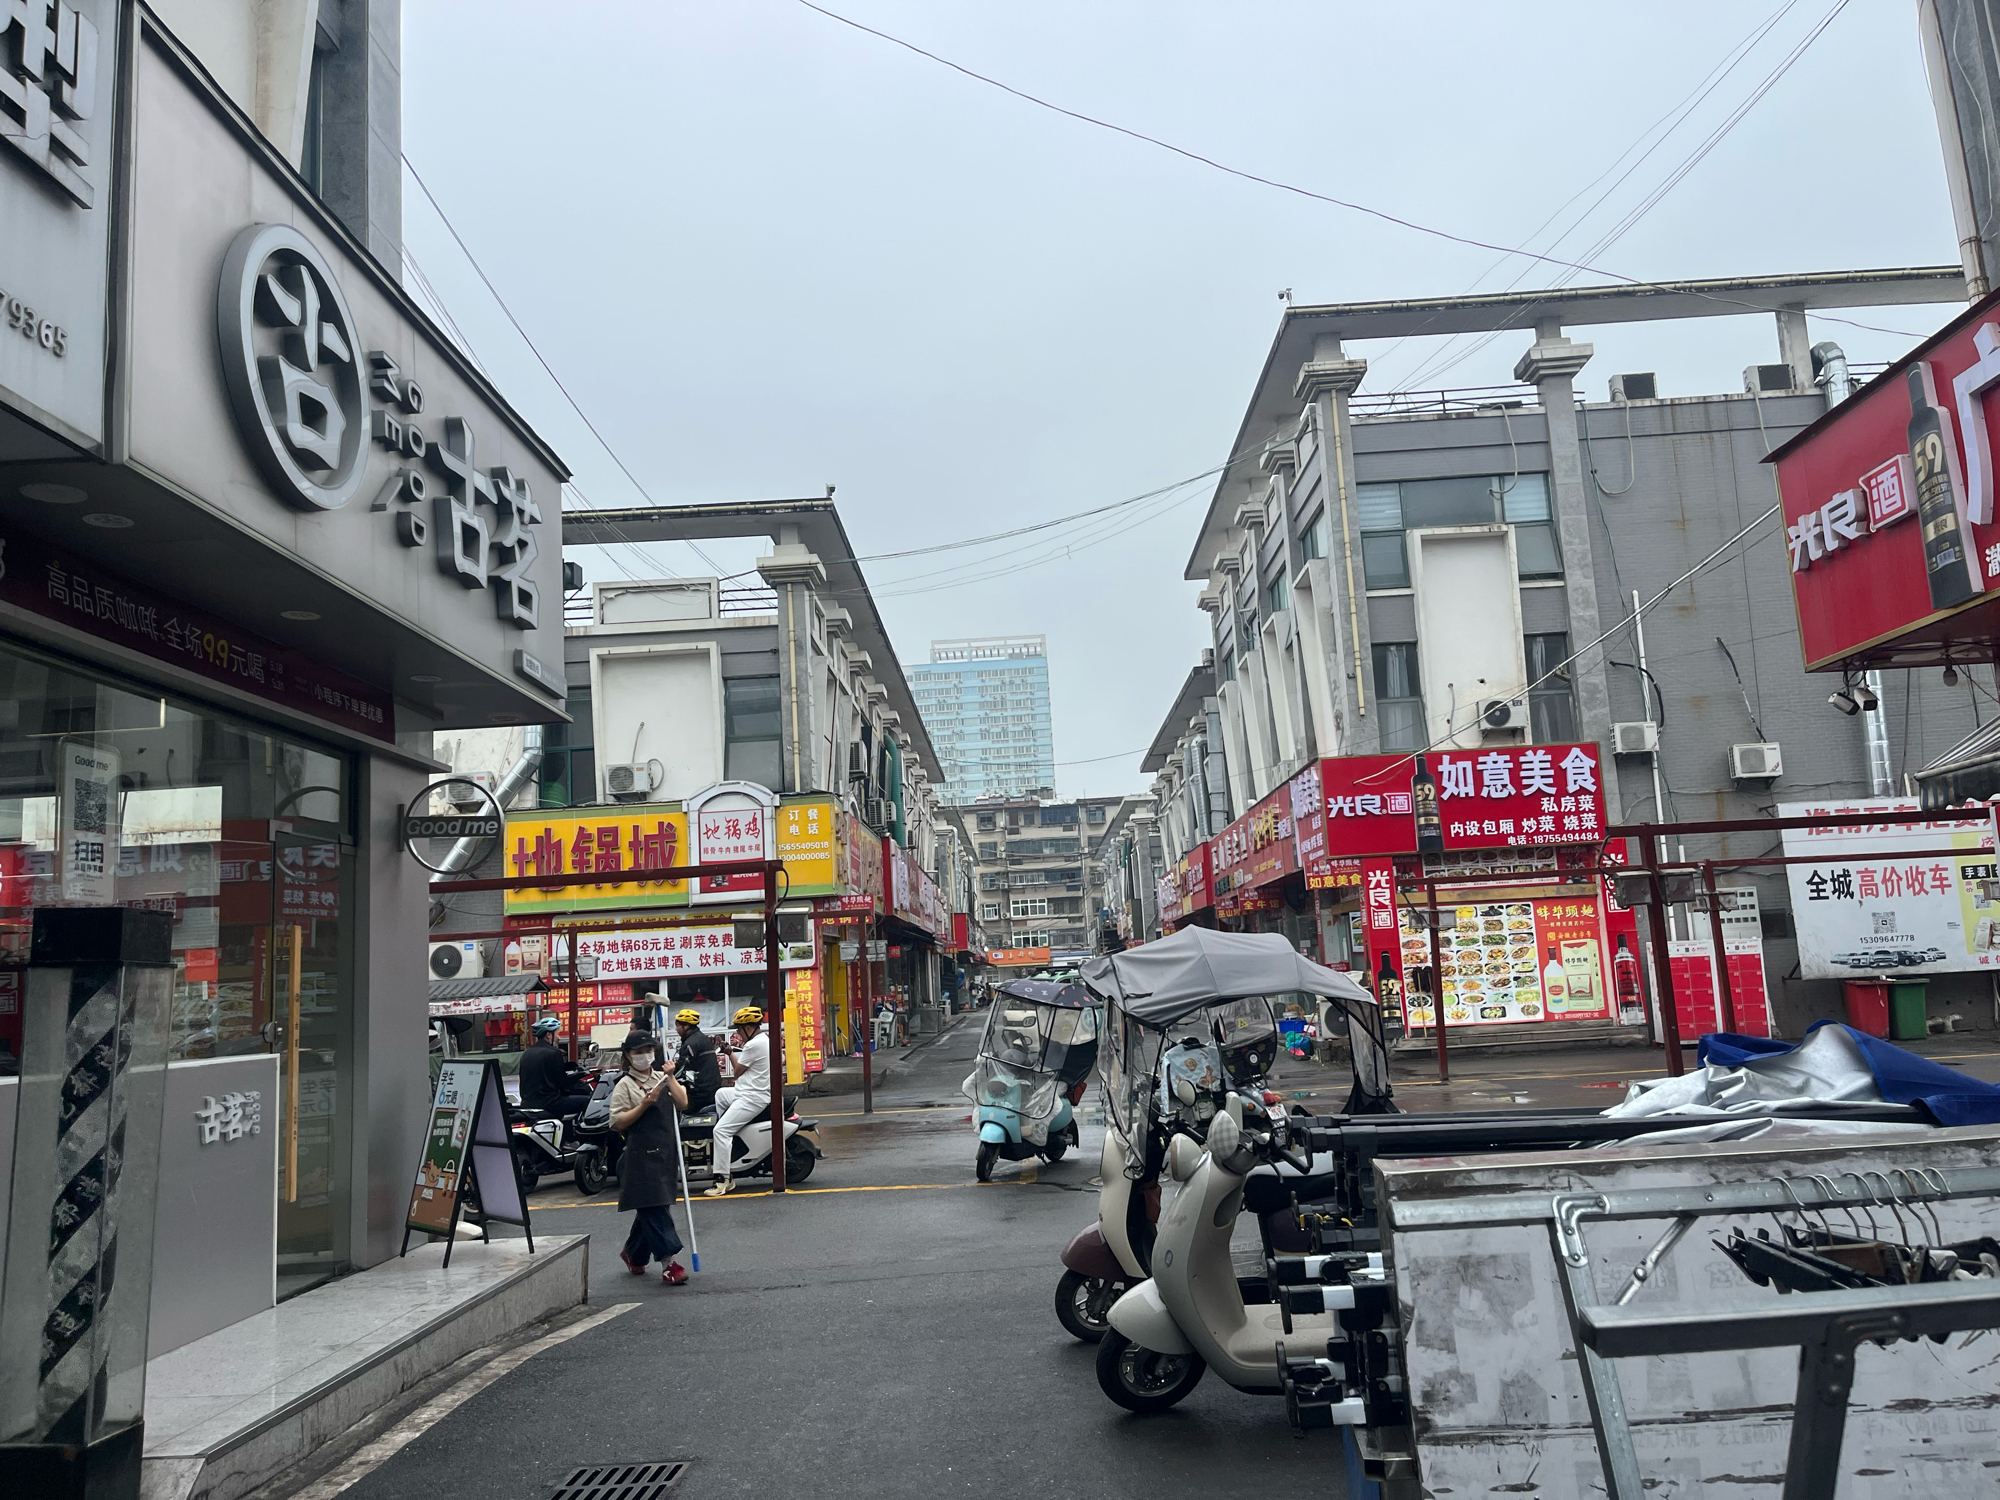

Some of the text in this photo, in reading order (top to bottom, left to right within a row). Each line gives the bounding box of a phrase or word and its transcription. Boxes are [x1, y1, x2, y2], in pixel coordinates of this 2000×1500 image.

[1913, 432, 1944, 486] 59
[426, 416, 544, 630] 古茗
[46, 563, 161, 641] 高品质咖啡
[314, 683, 384, 724] 小程序下单更优惠
[74, 755, 109, 771] Good me
[1437, 747, 1598, 801] 如意美食
[1416, 783, 1435, 801] 59
[1541, 795, 1595, 813] 私房菜
[406, 819, 499, 835] Good me
[703, 811, 761, 840] 地锅鸡
[1450, 812, 1598, 837] 内设包厢 炒菜 烧菜
[74, 839, 104, 863] 扫码
[512, 821, 678, 893] 地锅城
[778, 841, 829, 851] 15655405018
[1309, 873, 1362, 889] 如意美食
[1806, 863, 1952, 900] 全城高价收车
[1965, 866, 1987, 878] 手表
[579, 932, 733, 956] 全场地锅68元起 涮菜免费
[1557, 931, 1592, 940] 安徽老字号
[1859, 934, 1915, 944] 15309647778
[441, 1070, 455, 1086] 学生
[438, 1085, 458, 1105] 6元喝
[195, 1092, 243, 1144] 古茗
